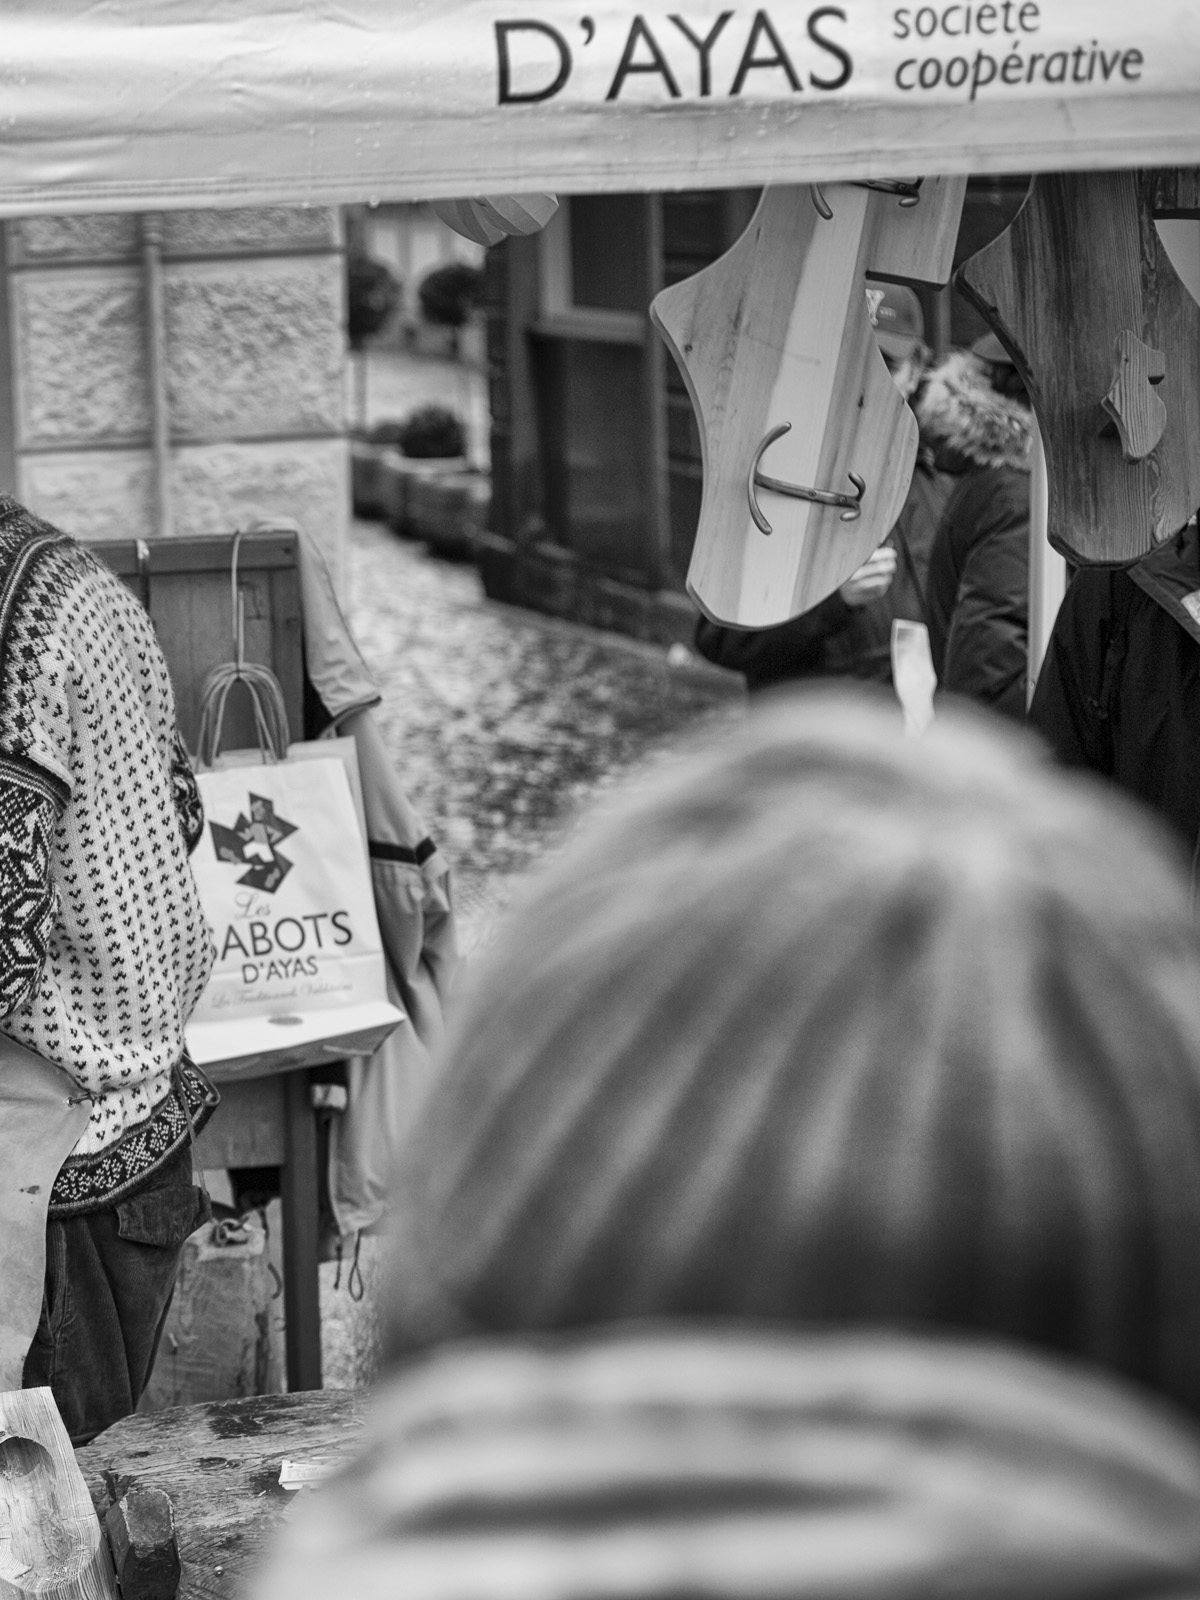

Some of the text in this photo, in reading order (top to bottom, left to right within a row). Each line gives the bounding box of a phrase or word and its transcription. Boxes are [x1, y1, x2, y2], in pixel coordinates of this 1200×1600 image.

[894, 40, 1144, 101] coopérative
[234, 890, 271, 920] Les
[208, 911, 353, 962] ABOTS
[241, 955, 319, 984] D'AYAS
